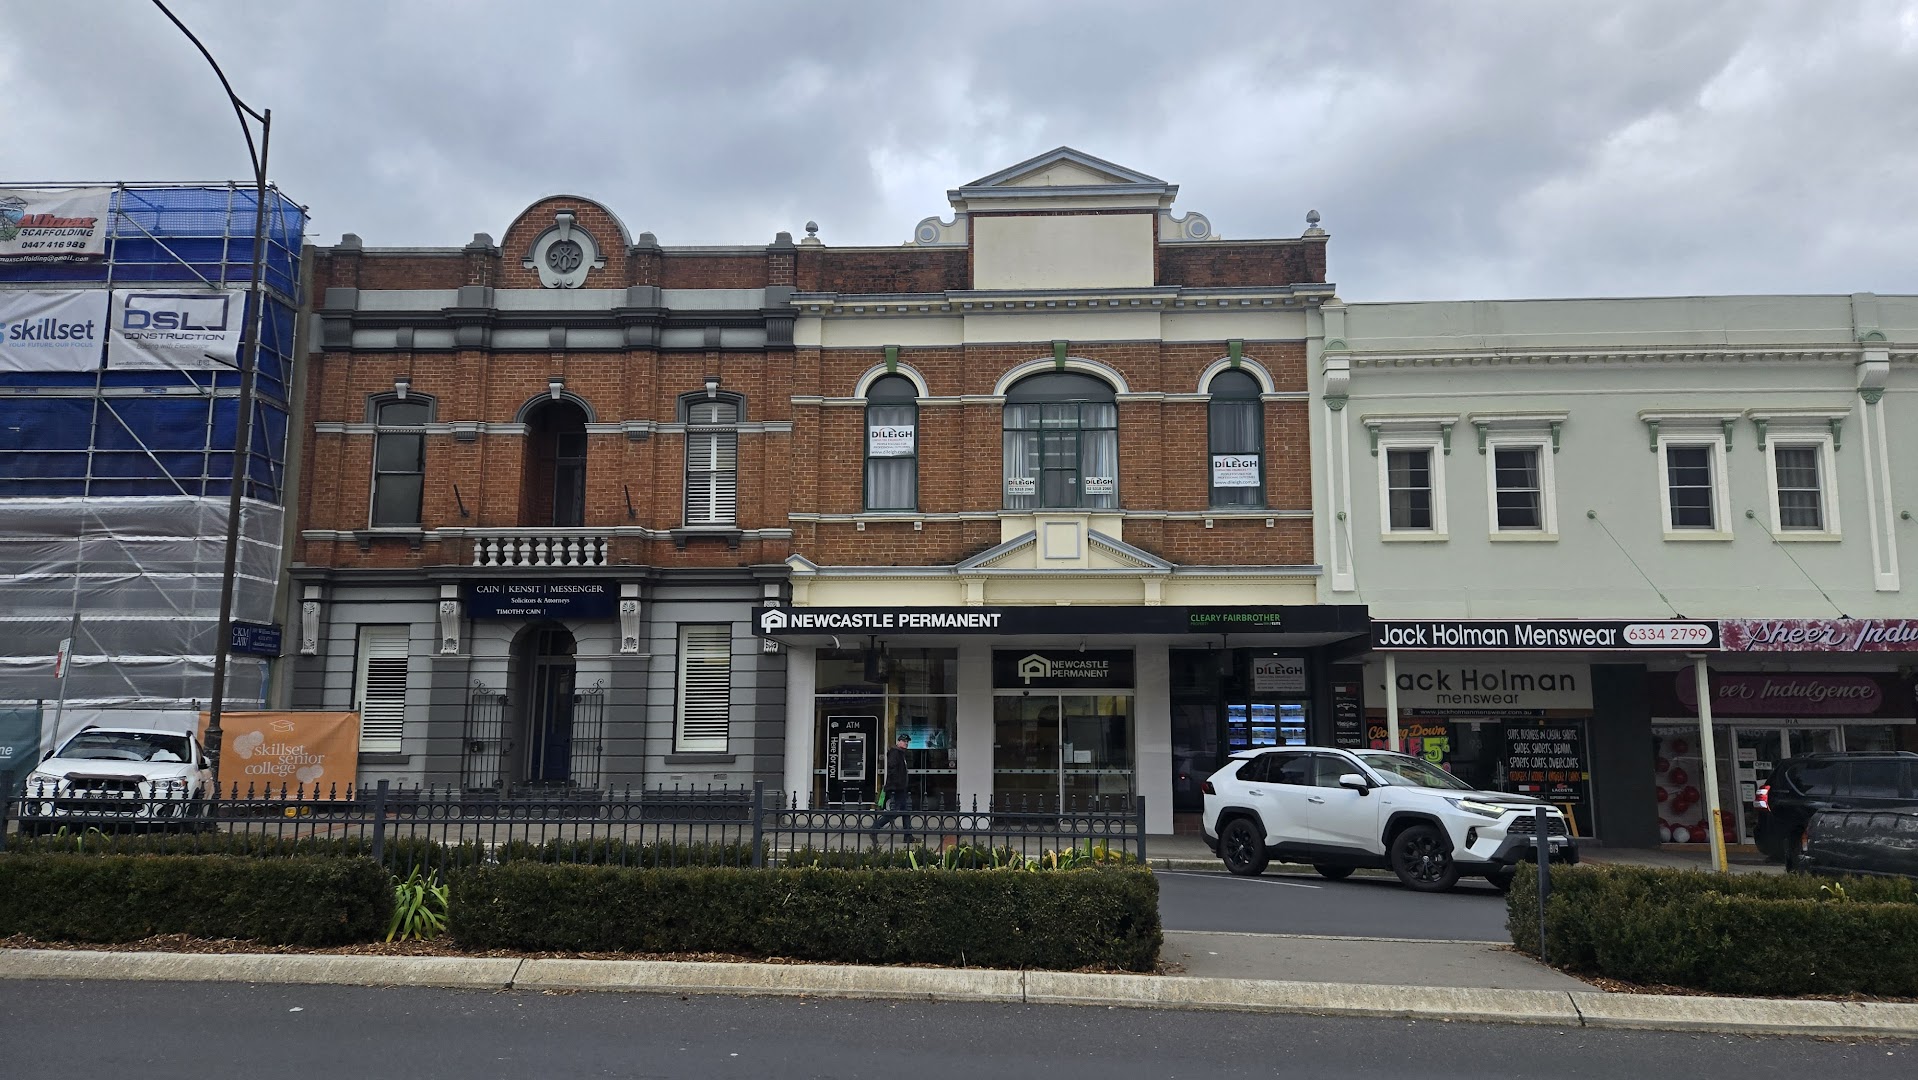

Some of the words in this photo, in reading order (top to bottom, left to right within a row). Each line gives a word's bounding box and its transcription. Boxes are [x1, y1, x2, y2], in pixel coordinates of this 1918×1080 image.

[21, 228, 94, 237] SCAFFOLDING
[21, 241, 45, 249] 0447
[66, 241, 86, 249] 988
[9, 318, 94, 340] skillset
[124, 332, 225, 341] CONSTRUCTION
[476, 585, 500, 593] CAIN
[508, 585, 541, 593] KENSIT
[550, 585, 604, 593] MESSENGER
[543, 597, 570, 605] Attorneys
[791, 613, 894, 628] NEWCASTLE
[898, 613, 1002, 628] PERMANENT
[1190, 614, 1221, 622] CLEARY
[1223, 614, 1281, 622] FAIRBROTHER
[232, 627, 250, 638] CKM
[1379, 624, 1428, 646] Jack
[1432, 624, 1509, 646] Holman
[1514, 624, 1616, 646] Menswear
[1629, 628, 1666, 641] 6334
[1670, 628, 1708, 641] 2799
[1748, 620, 1847, 649] Sheer
[232, 636, 249, 647] LAW
[1051, 660, 1109, 669] NEWCASTLE
[1051, 669, 1109, 678] PERMANENT
[1380, 669, 1452, 691] ack
[1461, 669, 1575, 691] Holman
[1719, 682, 1754, 698] eer
[1760, 679, 1874, 702] Indulgence
[1436, 693, 1519, 704] menswear
[846, 721, 860, 729] ATM
[1409, 724, 1447, 738] Down
[1520, 729, 1539, 740] BUSINESS
[830, 736, 839, 753] Here
[278, 754, 325, 765] senior
[829, 754, 839, 764] for
[1509, 757, 1529, 768] SPORTS
[1548, 757, 1579, 769] OVERCOATS
[244, 761, 296, 777] college
[829, 765, 837, 778] you
